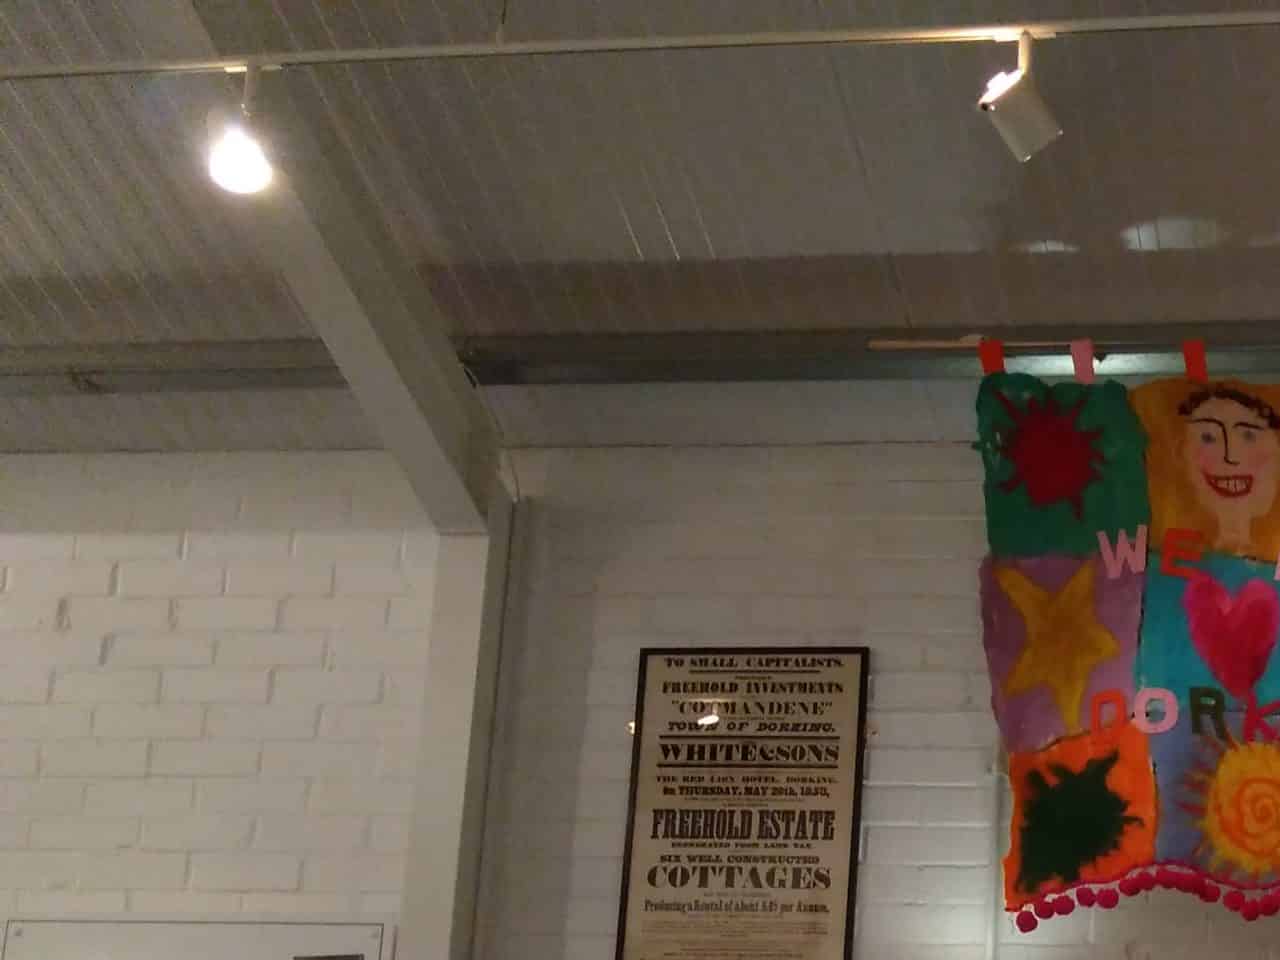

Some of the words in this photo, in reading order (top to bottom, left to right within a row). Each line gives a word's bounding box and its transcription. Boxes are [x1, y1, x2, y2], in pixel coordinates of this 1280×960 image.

[1096, 524, 1201, 579] WE
[665, 657, 684, 667] TO
[690, 657, 738, 668] SMALL
[662, 681, 739, 694] FREEHOLD
[726, 721, 750, 732] OF
[744, 787, 768, 796] MAY
[651, 809, 753, 840] FREEHOLD
[757, 809, 835, 840] ESTATE
[660, 855, 682, 864] SIX
[687, 855, 722, 864] WELL
[647, 866, 831, 889] COTTAGES
